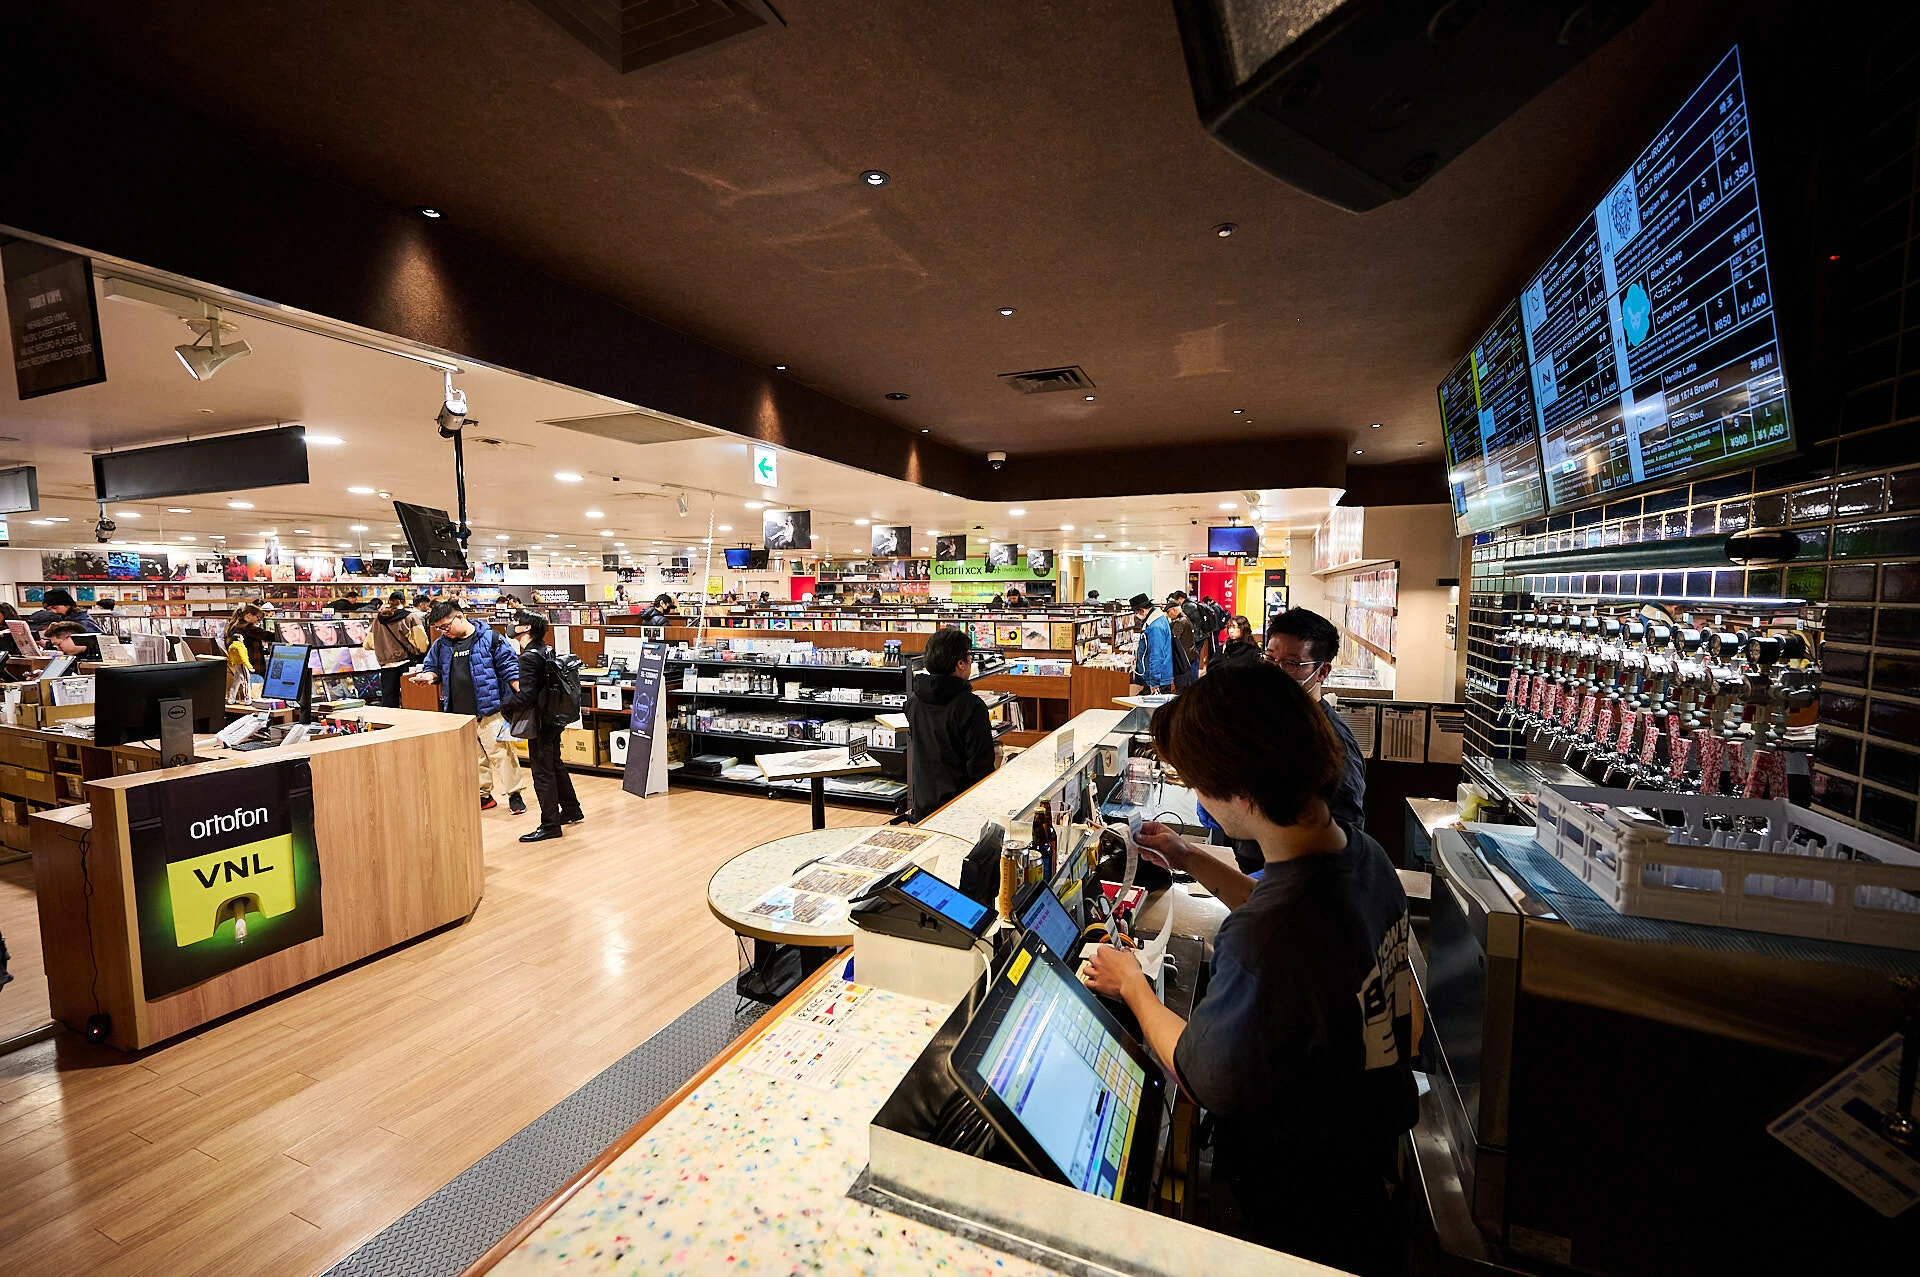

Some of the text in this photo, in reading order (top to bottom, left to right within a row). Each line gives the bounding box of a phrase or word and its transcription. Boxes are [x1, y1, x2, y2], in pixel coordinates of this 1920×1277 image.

[1639, 156, 1676, 198] U.B.P Brewery
[1723, 162, 1749, 190] ¥1,350
[1698, 191, 1715, 212] ¥800
[1650, 250, 1683, 281] Black Sheep
[1656, 298, 1689, 325] Coffee Porter
[1740, 292, 1767, 315] ¥1,400
[1714, 314, 1732, 331] ¥850
[1664, 362, 1697, 385] Vanilla Latte
[1693, 378, 1719, 395] Brewery
[1671, 409, 1704, 429] Golden Stout
[1729, 433, 1748, 448] ¥900
[1757, 423, 1784, 441] ¥1,450
[935, 564, 964, 576] Charli
[190, 807, 269, 839] ortofon
[193, 853, 274, 889] VNL
